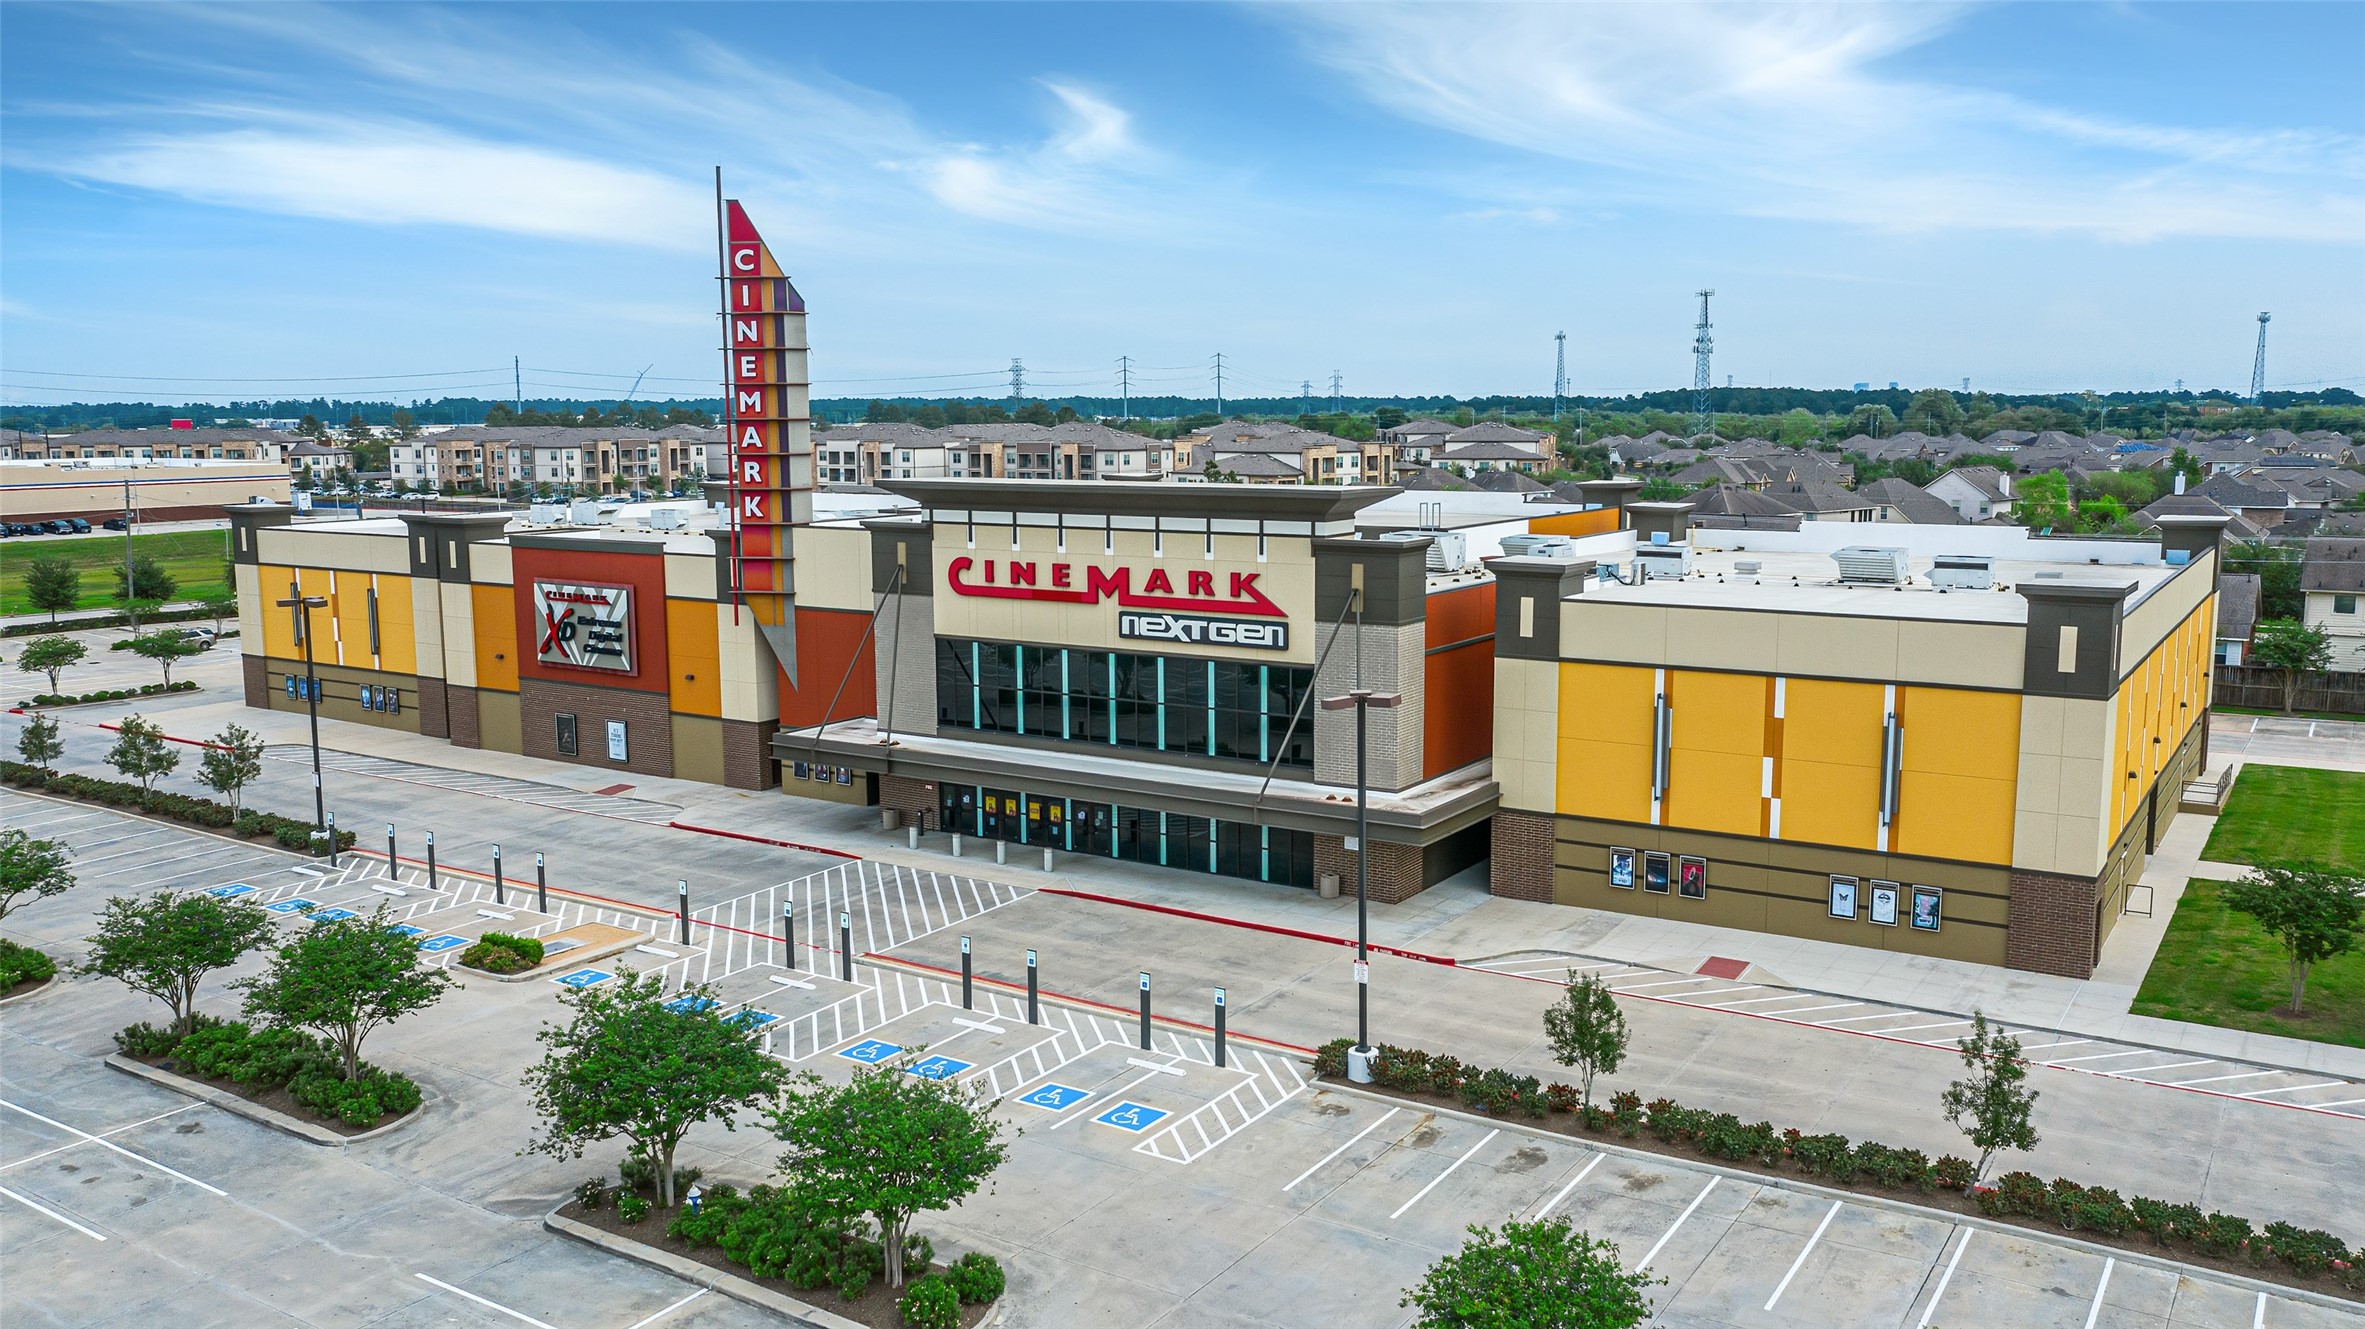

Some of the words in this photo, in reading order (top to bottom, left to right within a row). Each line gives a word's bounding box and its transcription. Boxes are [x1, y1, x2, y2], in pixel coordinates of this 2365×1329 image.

[734, 249, 764, 518] CINEMARK
[948, 556, 1288, 617] CINEMARK
[545, 590, 612, 605] CINEMARK
[577, 616, 622, 628] Extreme
[589, 630, 623, 643] Digital
[583, 643, 623, 656] Cinema
